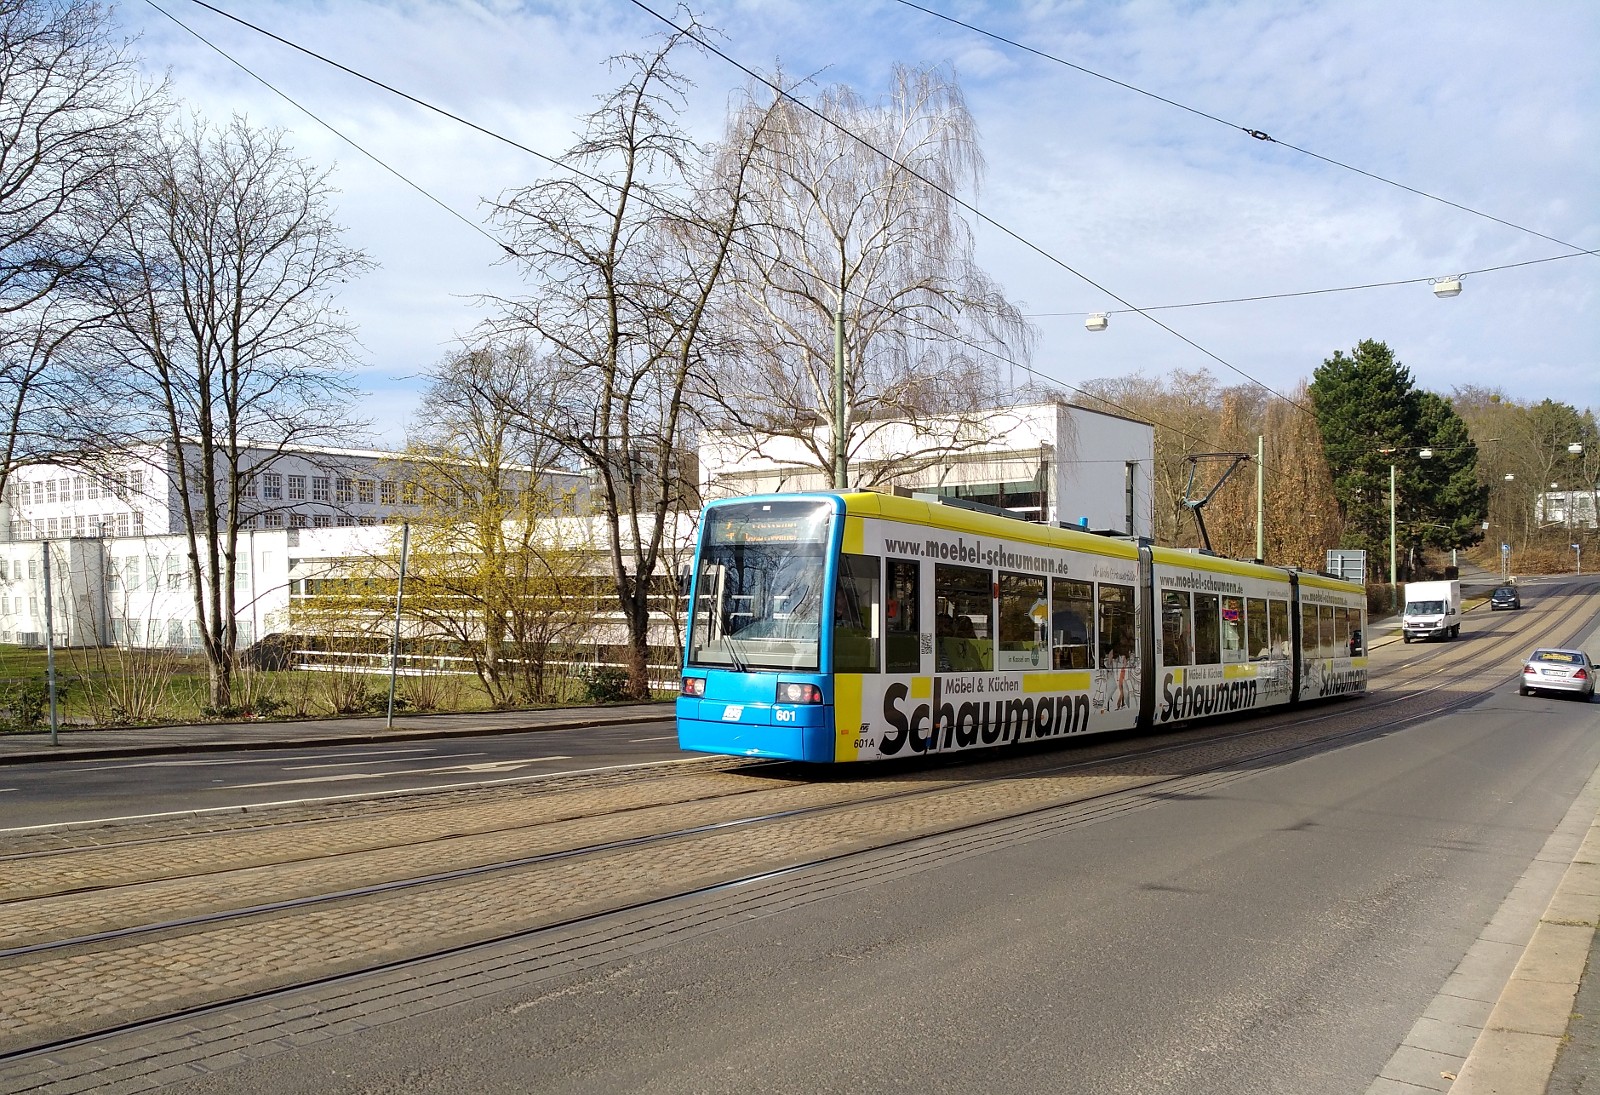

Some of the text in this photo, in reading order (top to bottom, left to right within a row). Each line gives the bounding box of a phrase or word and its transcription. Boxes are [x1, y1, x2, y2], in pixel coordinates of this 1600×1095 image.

[885, 538, 1068, 574] www.moebel-schaumann.de
[1160, 572, 1243, 594] www.moebel-schaumann.de
[945, 676, 1018, 694] Möbel & Küchen
[1161, 668, 1257, 722] Schaumann
[776, 710, 796, 722] 601
[879, 677, 1089, 755] Schaumann
[853, 738, 875, 749] 601A
